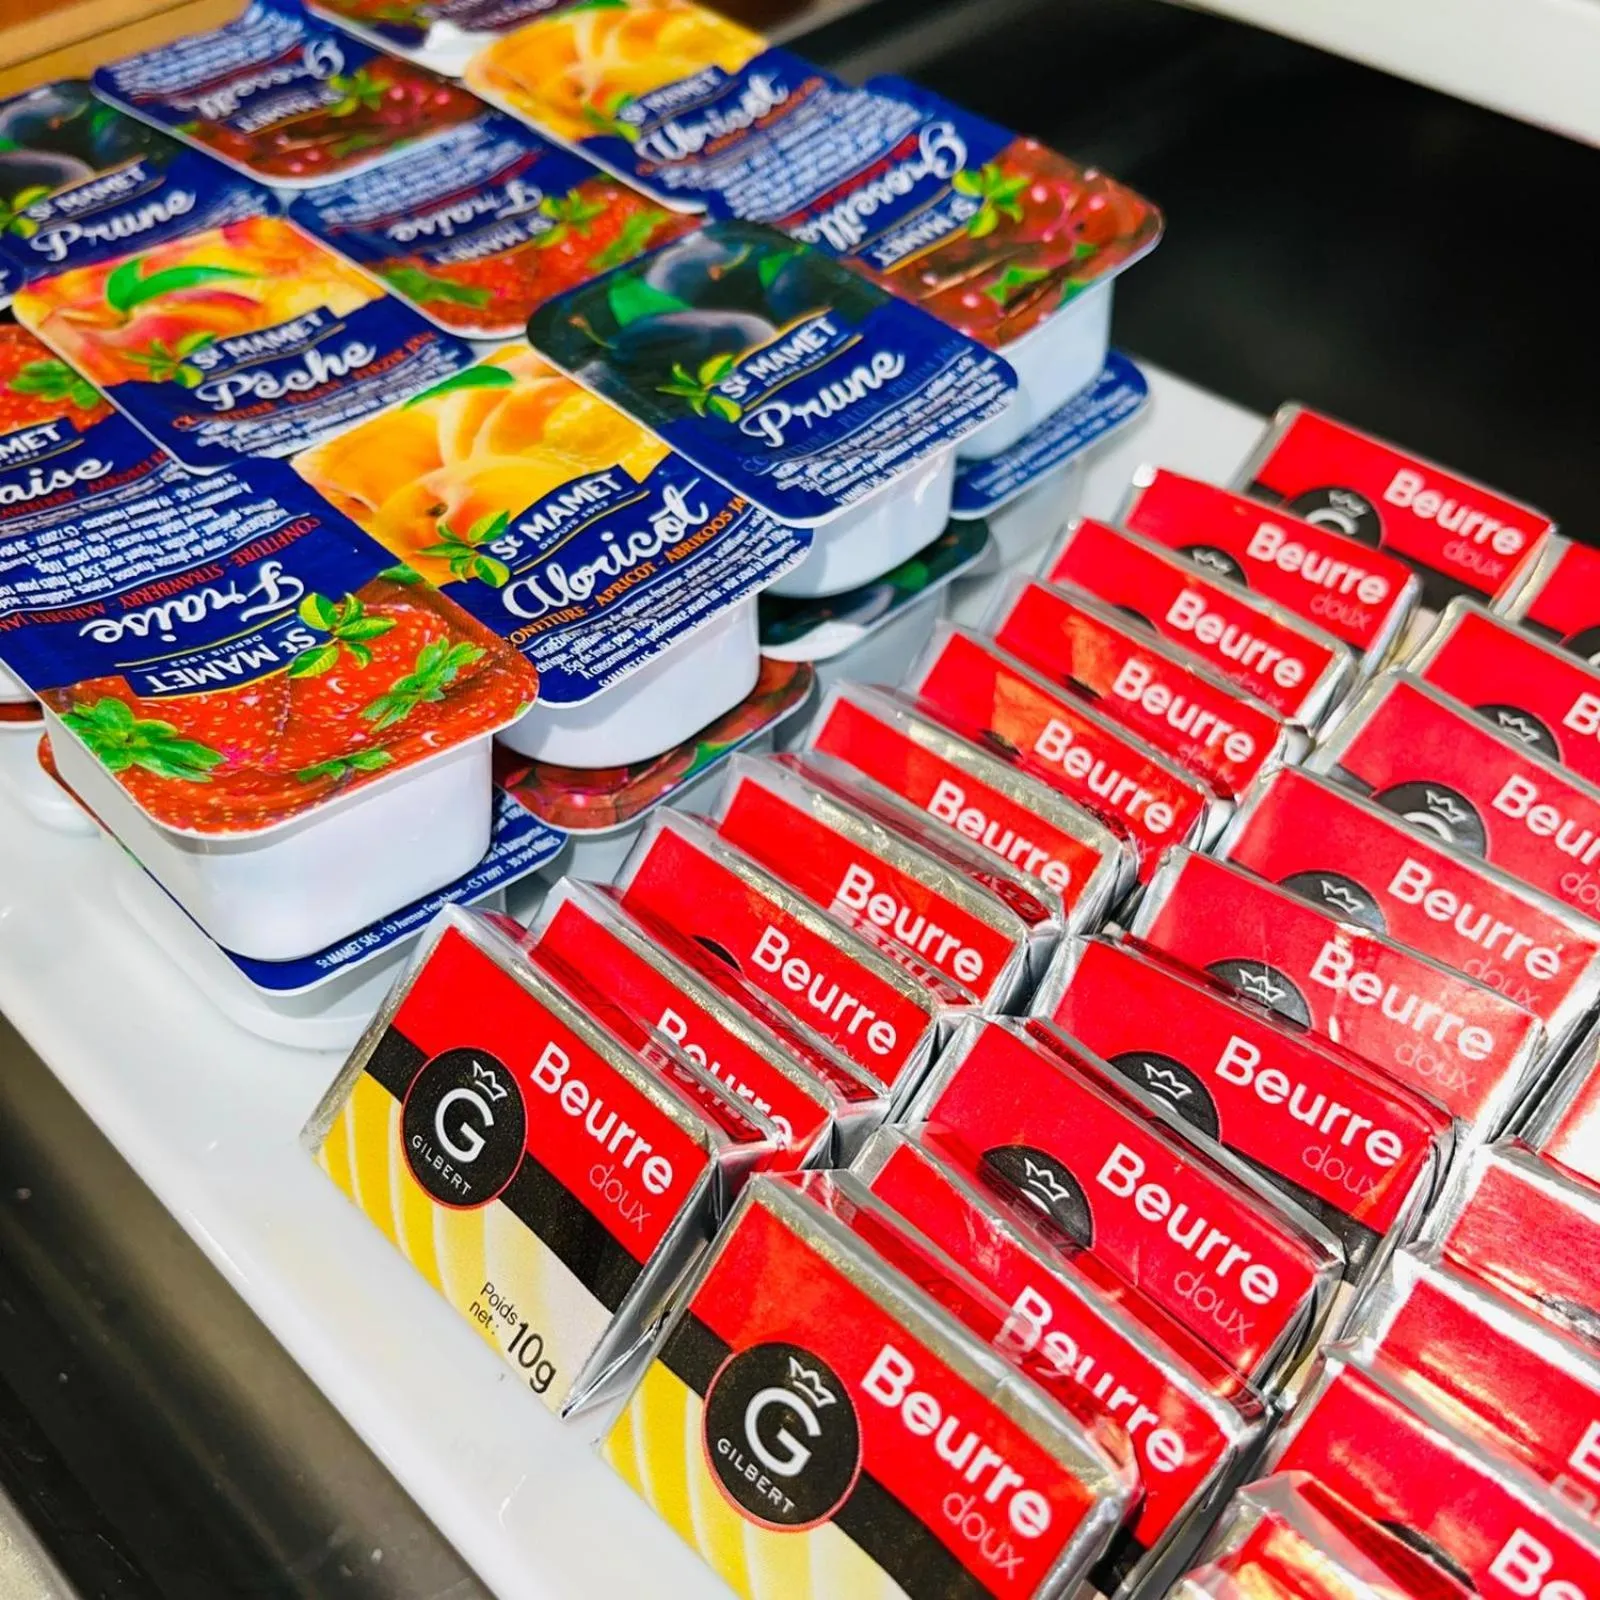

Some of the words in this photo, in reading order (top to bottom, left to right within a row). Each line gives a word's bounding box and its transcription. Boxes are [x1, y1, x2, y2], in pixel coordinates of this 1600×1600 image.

[30, 188, 197, 262] Prune
[195, 341, 377, 411] Pêche
[745, 315, 837, 380] MAMET
[740, 348, 905, 448] Prune
[0, 423, 61, 461] MET
[0, 459, 113, 505] aise
[518, 473, 621, 541] MAMET
[1383, 468, 1525, 555] Beurre
[119, 565, 224, 609] STRAWBERRY
[502, 478, 709, 619] Abricot
[509, 605, 588, 651] ONFITURE
[595, 561, 658, 607] APRICOT
[664, 510, 733, 564] ABRIKOOS
[1246, 522, 1390, 605] Beurre
[1442, 539, 1503, 579] doux
[79, 561, 304, 643] Fraise
[278, 627, 319, 654] St
[1164, 588, 1305, 688] Beurre
[145, 636, 280, 700] MAMET
[1112, 658, 1255, 763] Beurre
[1034, 719, 1175, 833] Beurre
[927, 779, 1071, 893] Beurre
[1491, 774, 1600, 868] Beur
[835, 864, 985, 982] Beurre
[1387, 857, 1561, 980] Beurre
[750, 925, 898, 1055] Beurre
[1309, 942, 1495, 1061] Beurre
[1214, 1036, 1404, 1168] Beurre
[1395, 1040, 1476, 1096] doux
[434, 1088, 495, 1164] G
[529, 1041, 674, 1195] Beurre
[412, 1135, 473, 1197] GILBERT
[588, 1162, 653, 1234] doux
[1302, 1142, 1378, 1204] doux
[1096, 1143, 1279, 1305] Beurre
[468, 1300, 491, 1330] net
[480, 1282, 518, 1327] Poids
[1173, 1270, 1255, 1343] doux
[506, 1321, 557, 1395] 10g
[744, 1387, 822, 1477] G
[860, 1345, 1052, 1537] Beurre
[716, 1437, 796, 1514] GILBERT
[942, 1491, 1025, 1581] doux
